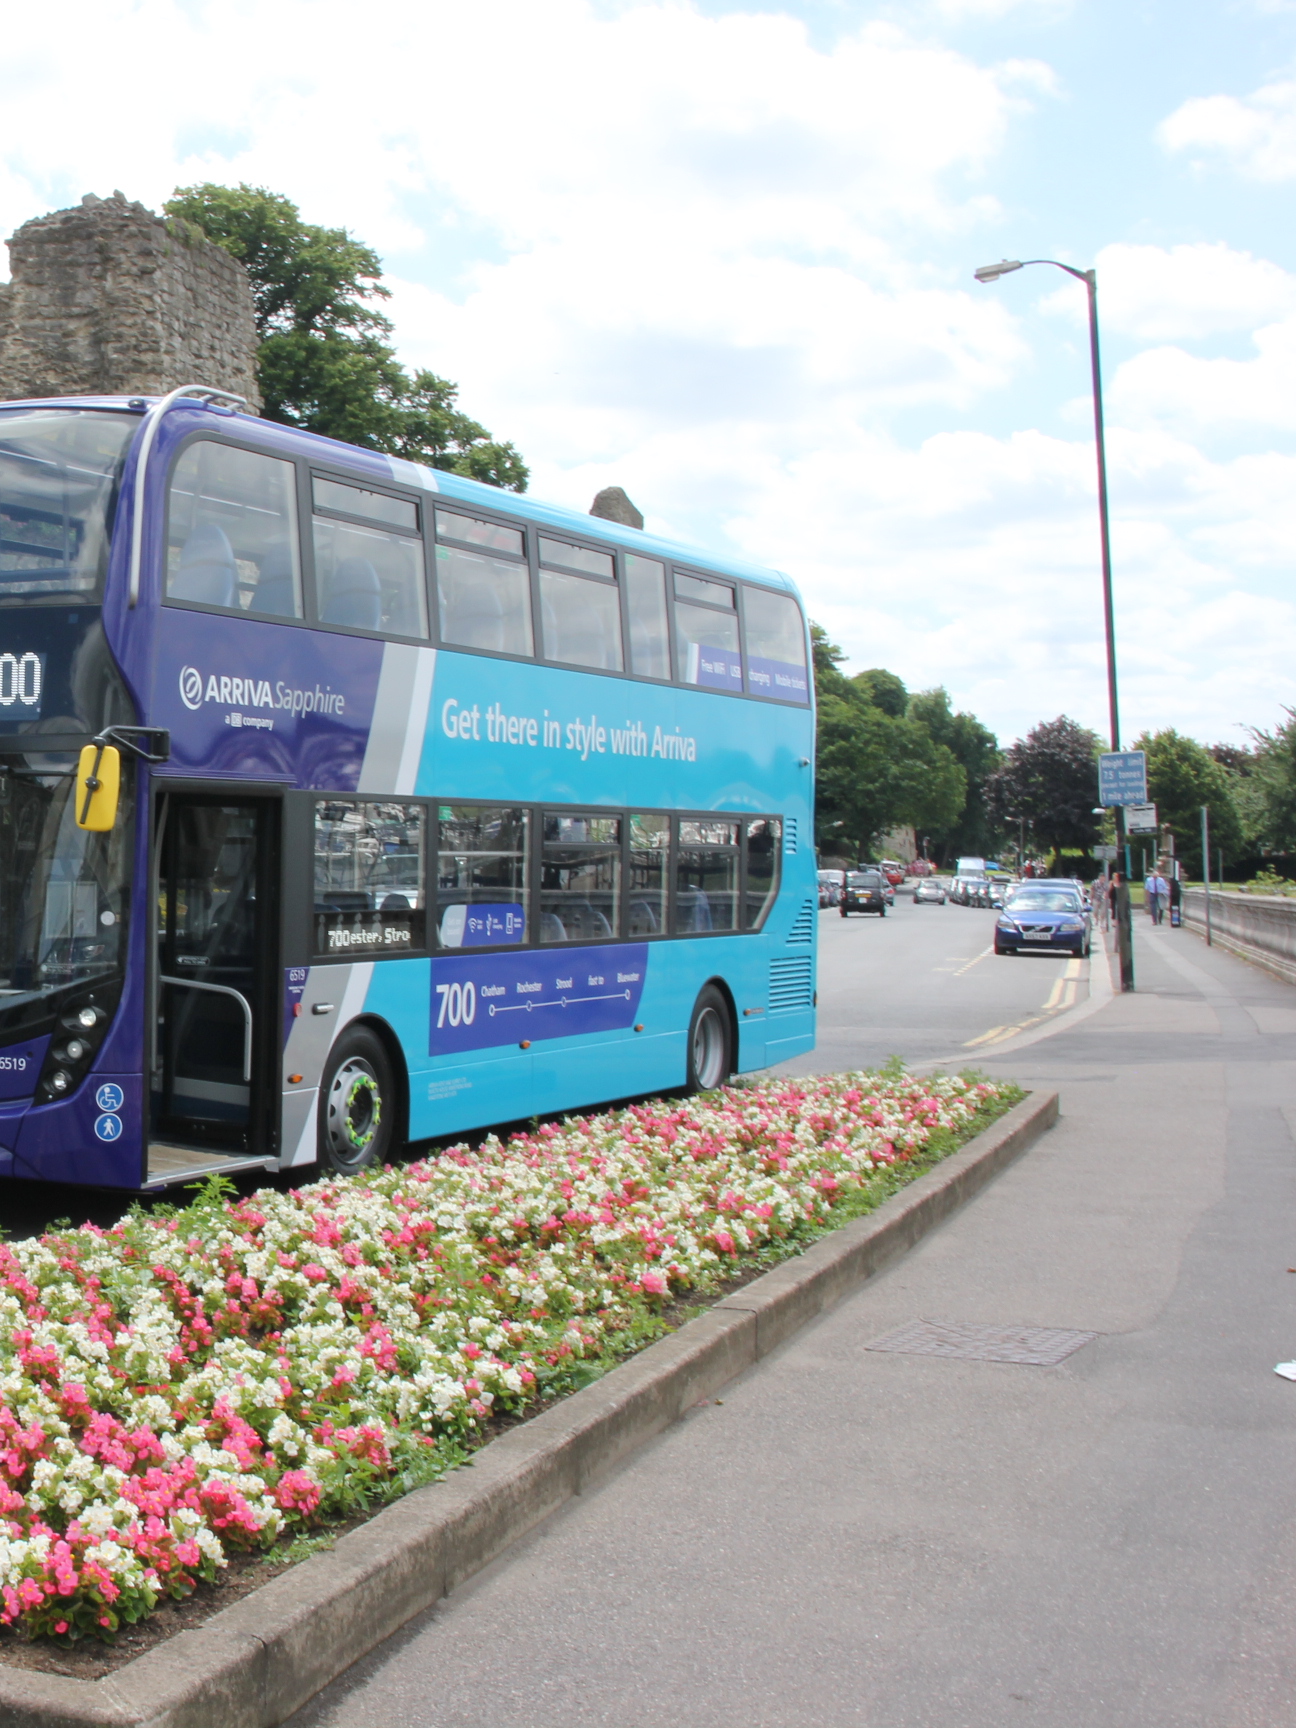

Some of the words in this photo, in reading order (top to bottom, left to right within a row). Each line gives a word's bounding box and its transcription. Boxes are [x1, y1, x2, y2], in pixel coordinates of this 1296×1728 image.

[205, 675, 274, 708] ARRIVA
[274, 681, 345, 718] Sapphire
[225, 715, 230, 724] a
[243, 717, 274, 731] company
[442, 698, 481, 741] Get
[486, 702, 537, 746] there
[543, 710, 561, 748] in
[566, 715, 606, 761] style
[610, 720, 648, 757] with
[652, 725, 697, 762] Arriva
[327, 930, 350, 947] 700
[289, 968, 306, 981] 6519
[481, 985, 505, 997] Chatham
[516, 981, 542, 994] Rochester
[555, 977, 573, 989] Strood
[617, 972, 640, 983] Bluewater
[435, 981, 476, 1028] 700
